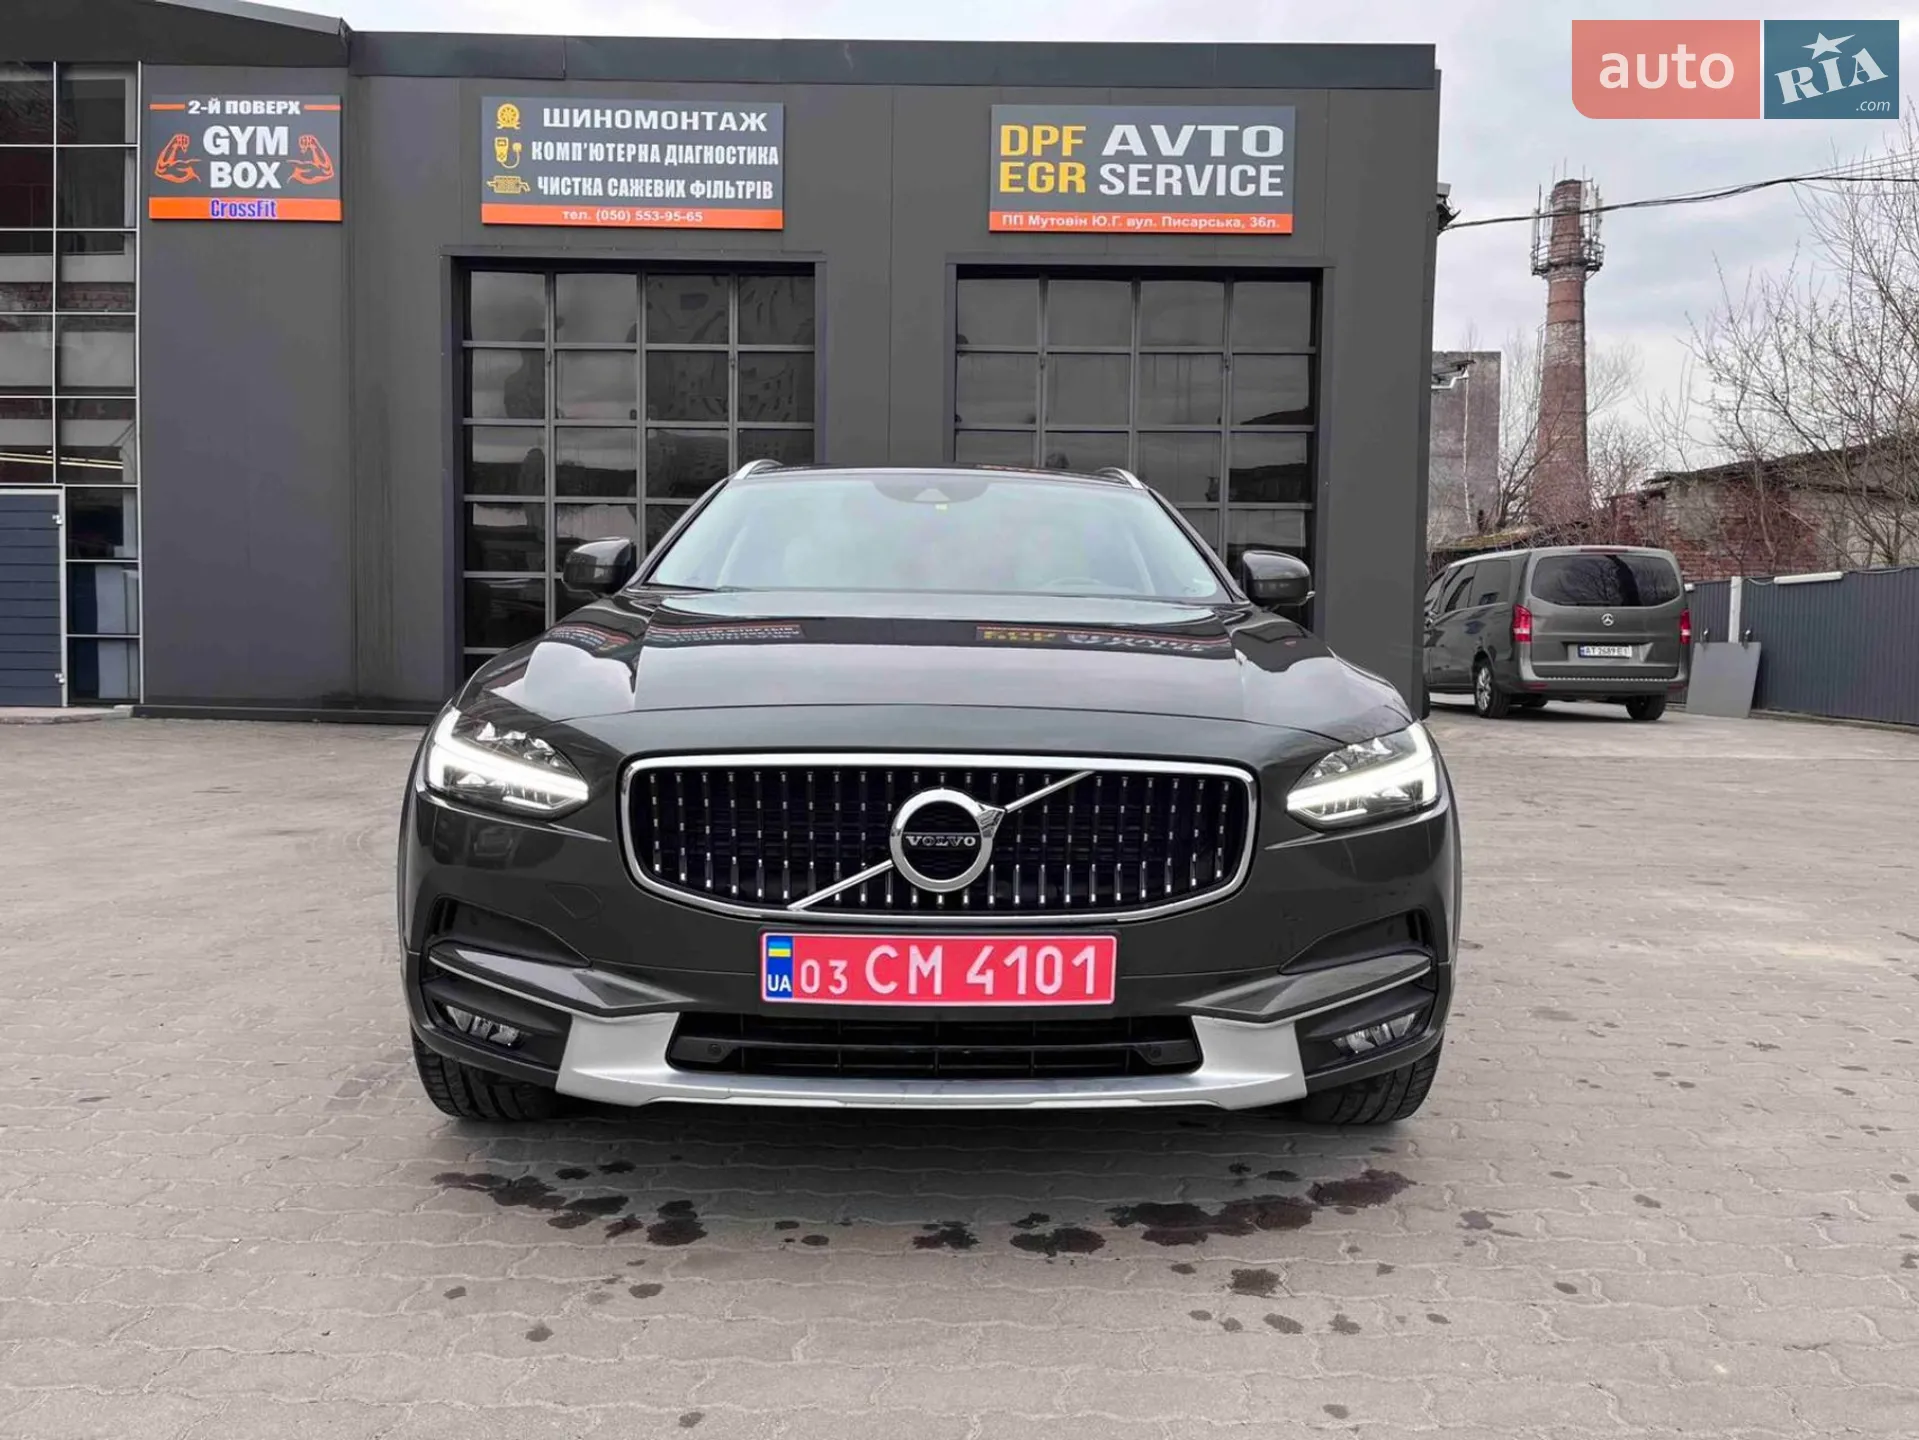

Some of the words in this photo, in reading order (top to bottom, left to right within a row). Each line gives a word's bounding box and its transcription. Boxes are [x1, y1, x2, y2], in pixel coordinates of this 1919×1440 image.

[188, 97, 220, 115] 2-Й
[225, 100, 301, 115] ПОВЕРХ
[543, 107, 768, 132] ШИНОМОНТАЖ
[202, 125, 289, 156] GYM
[1000, 124, 1087, 157] DPF
[1101, 124, 1284, 158] AVTO
[531, 141, 661, 164] КОМП'ЮТЕРНА
[664, 145, 779, 167] ДІАГНОСТИКА
[210, 161, 281, 189] BOX
[999, 161, 1087, 193] EGR
[1099, 163, 1284, 196] SERVICE
[537, 176, 603, 197] ЧИСТКА
[607, 177, 686, 199] САЖЕВИХ
[689, 180, 773, 200] ФІЛЬТРІВ
[210, 199, 277, 218] CrossFit
[562, 210, 592, 220] тел.
[596, 209, 631, 222] (050)
[635, 210, 704, 222] 553-95-65
[1002, 215, 1024, 226] ПП
[1028, 215, 1088, 229] Мутовін
[1092, 215, 1122, 226] Ю.Г.
[1126, 216, 1157, 229] вул.
[1162, 216, 1245, 230] Писарська,
[905, 836, 976, 846] VOLVO
[767, 974, 792, 992] UA
[800, 959, 848, 994] 03
[865, 945, 943, 995] CM
[966, 945, 1096, 995] 4101
